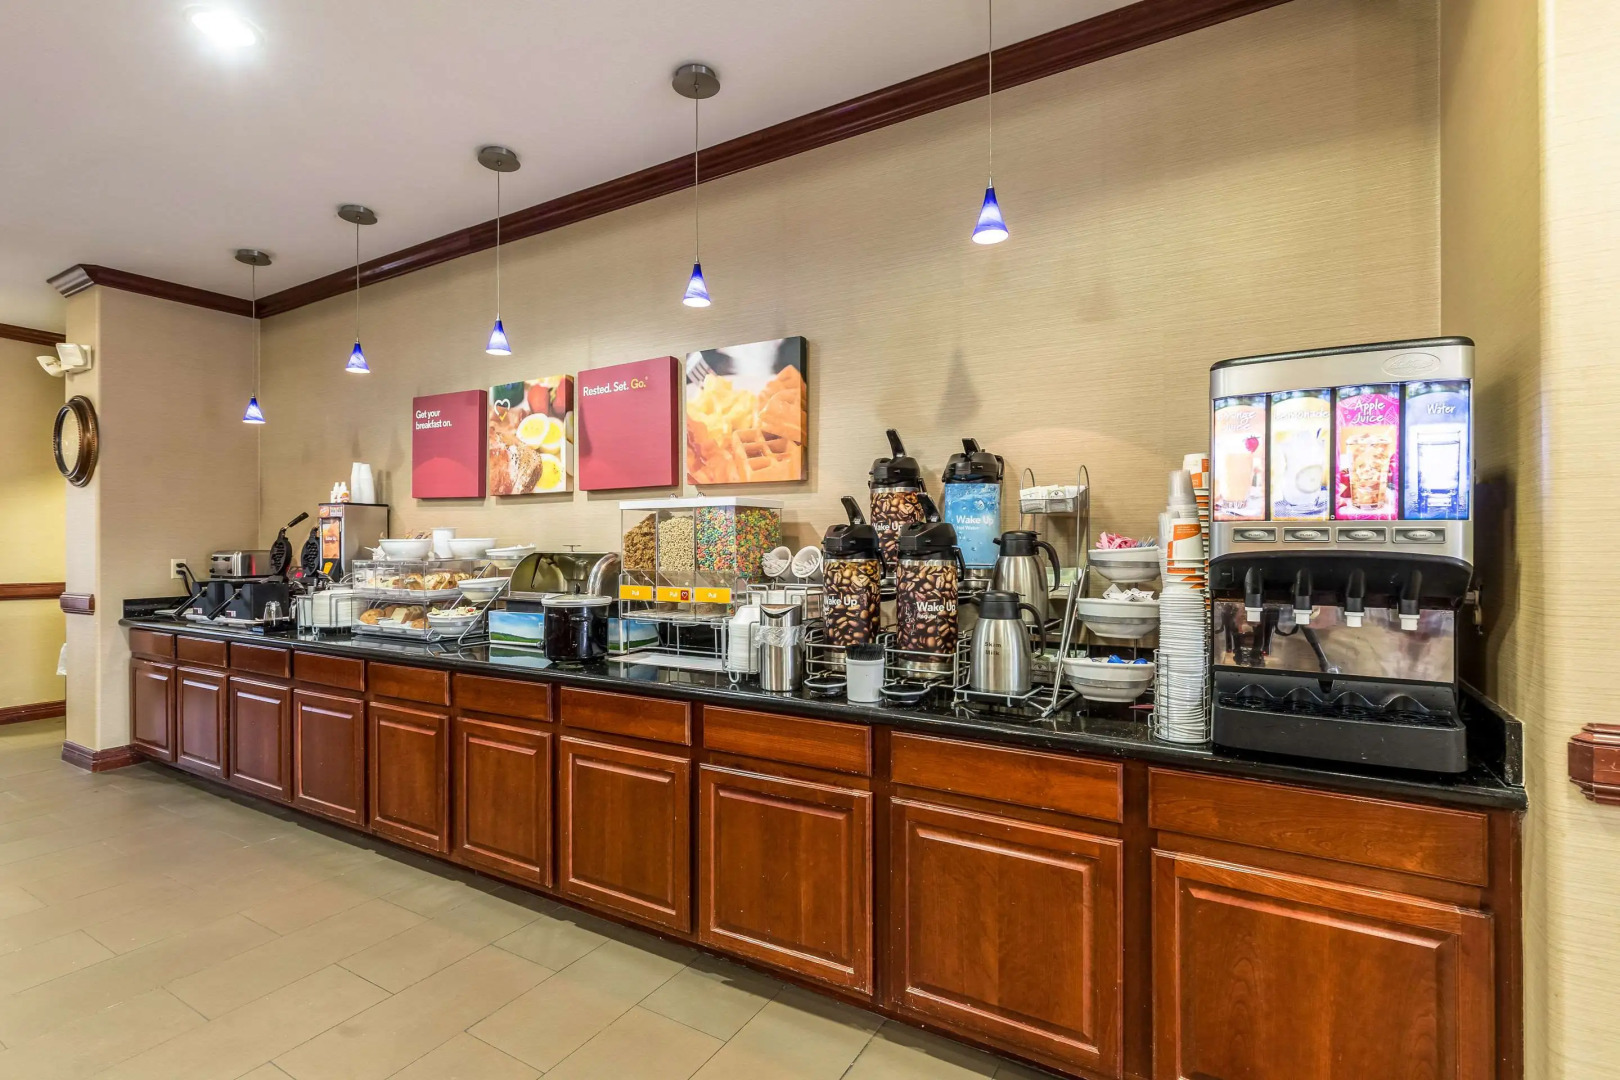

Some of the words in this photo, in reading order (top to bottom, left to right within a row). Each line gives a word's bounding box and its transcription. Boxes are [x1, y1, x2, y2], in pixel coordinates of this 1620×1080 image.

[583, 382, 612, 396] Rested.
[613, 381, 629, 392] Set.
[1354, 399, 1385, 416] Apple
[1427, 403, 1456, 415] Water
[415, 410, 427, 419] Get
[427, 410, 440, 419] your
[1352, 412, 1384, 425] Juice
[415, 419, 442, 430] breakfast
[442, 420, 453, 428] on.
[956, 515, 981, 524] Wake
[982, 515, 994, 526] Up
[843, 596, 858, 607] Up
[916, 601, 945, 612] Wake
[946, 601, 956, 613] Up
